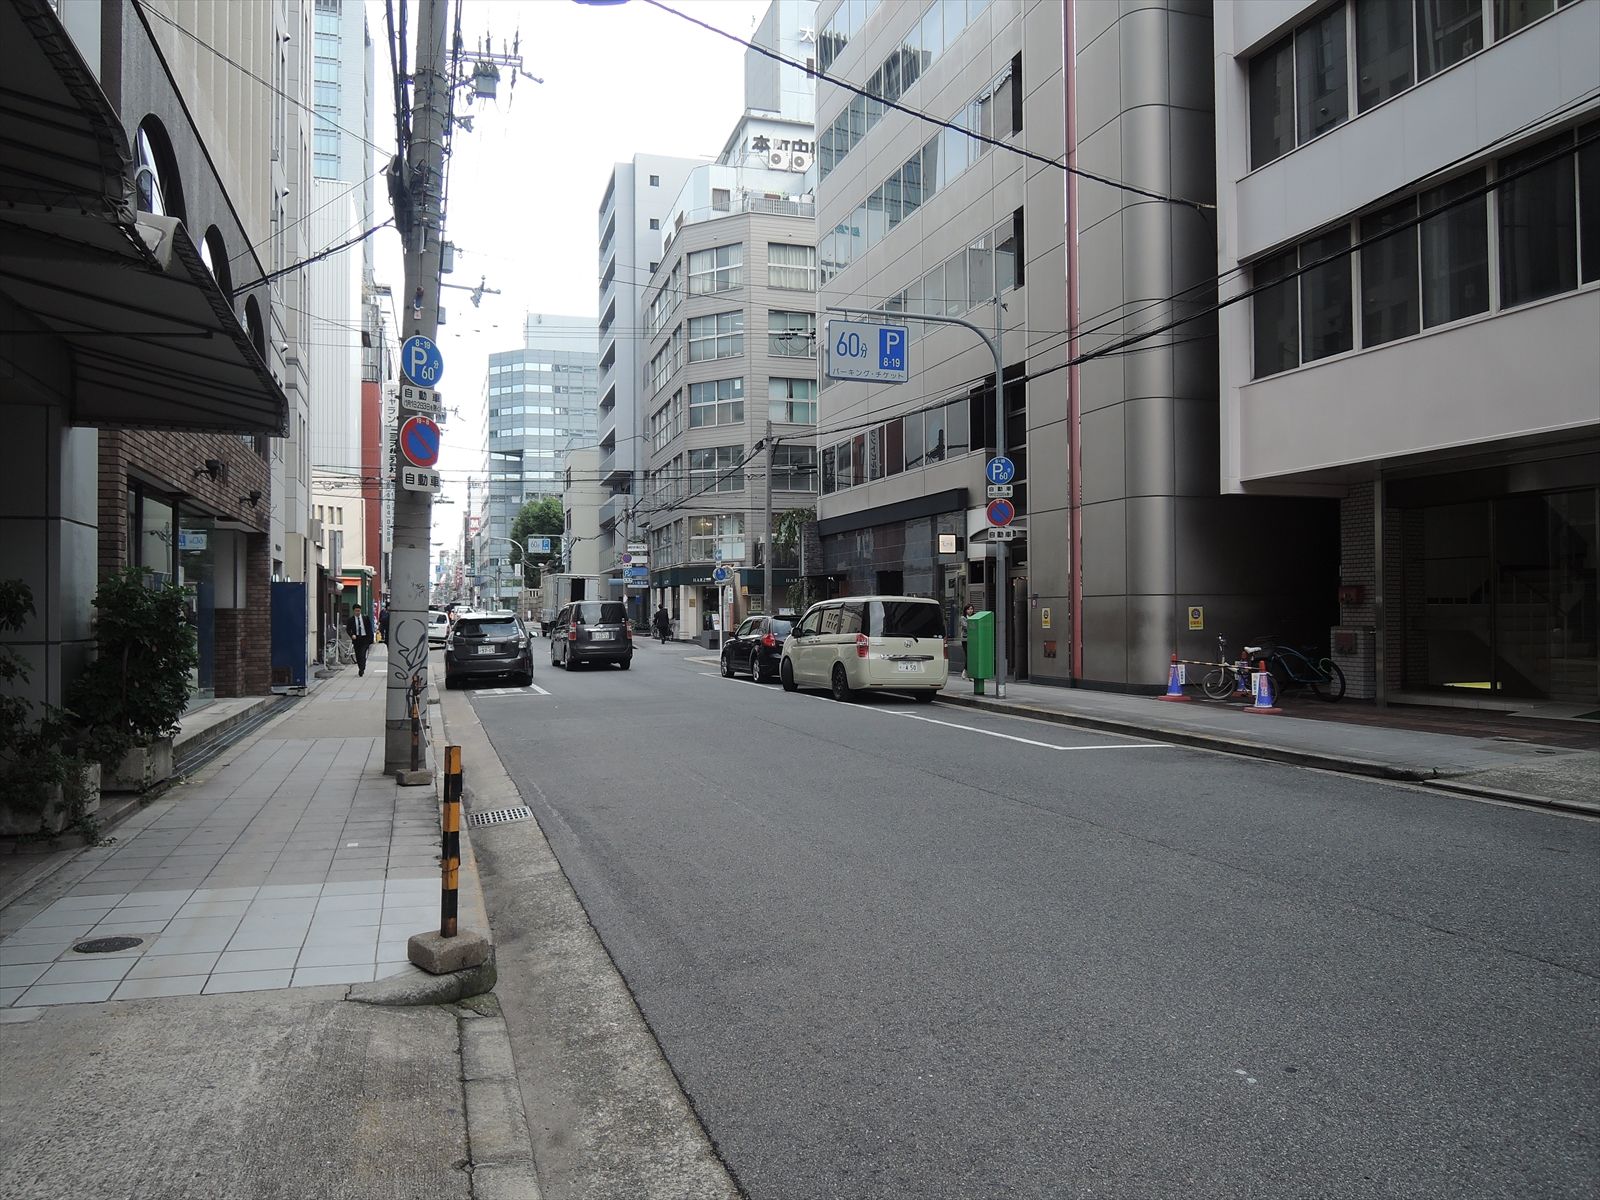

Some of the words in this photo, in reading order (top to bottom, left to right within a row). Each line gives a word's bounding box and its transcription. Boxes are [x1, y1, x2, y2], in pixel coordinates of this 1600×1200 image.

[415, 339, 430, 349] 8-19
[836, 331, 868, 358] 60分
[886, 332, 900, 355] P
[411, 346, 428, 377] P
[883, 357, 901, 368] 8-19
[832, 368, 904, 379] パーキング・チケット
[404, 388, 441, 402] 自動車
[992, 463, 1004, 480] P
[404, 472, 440, 488] 自動車
